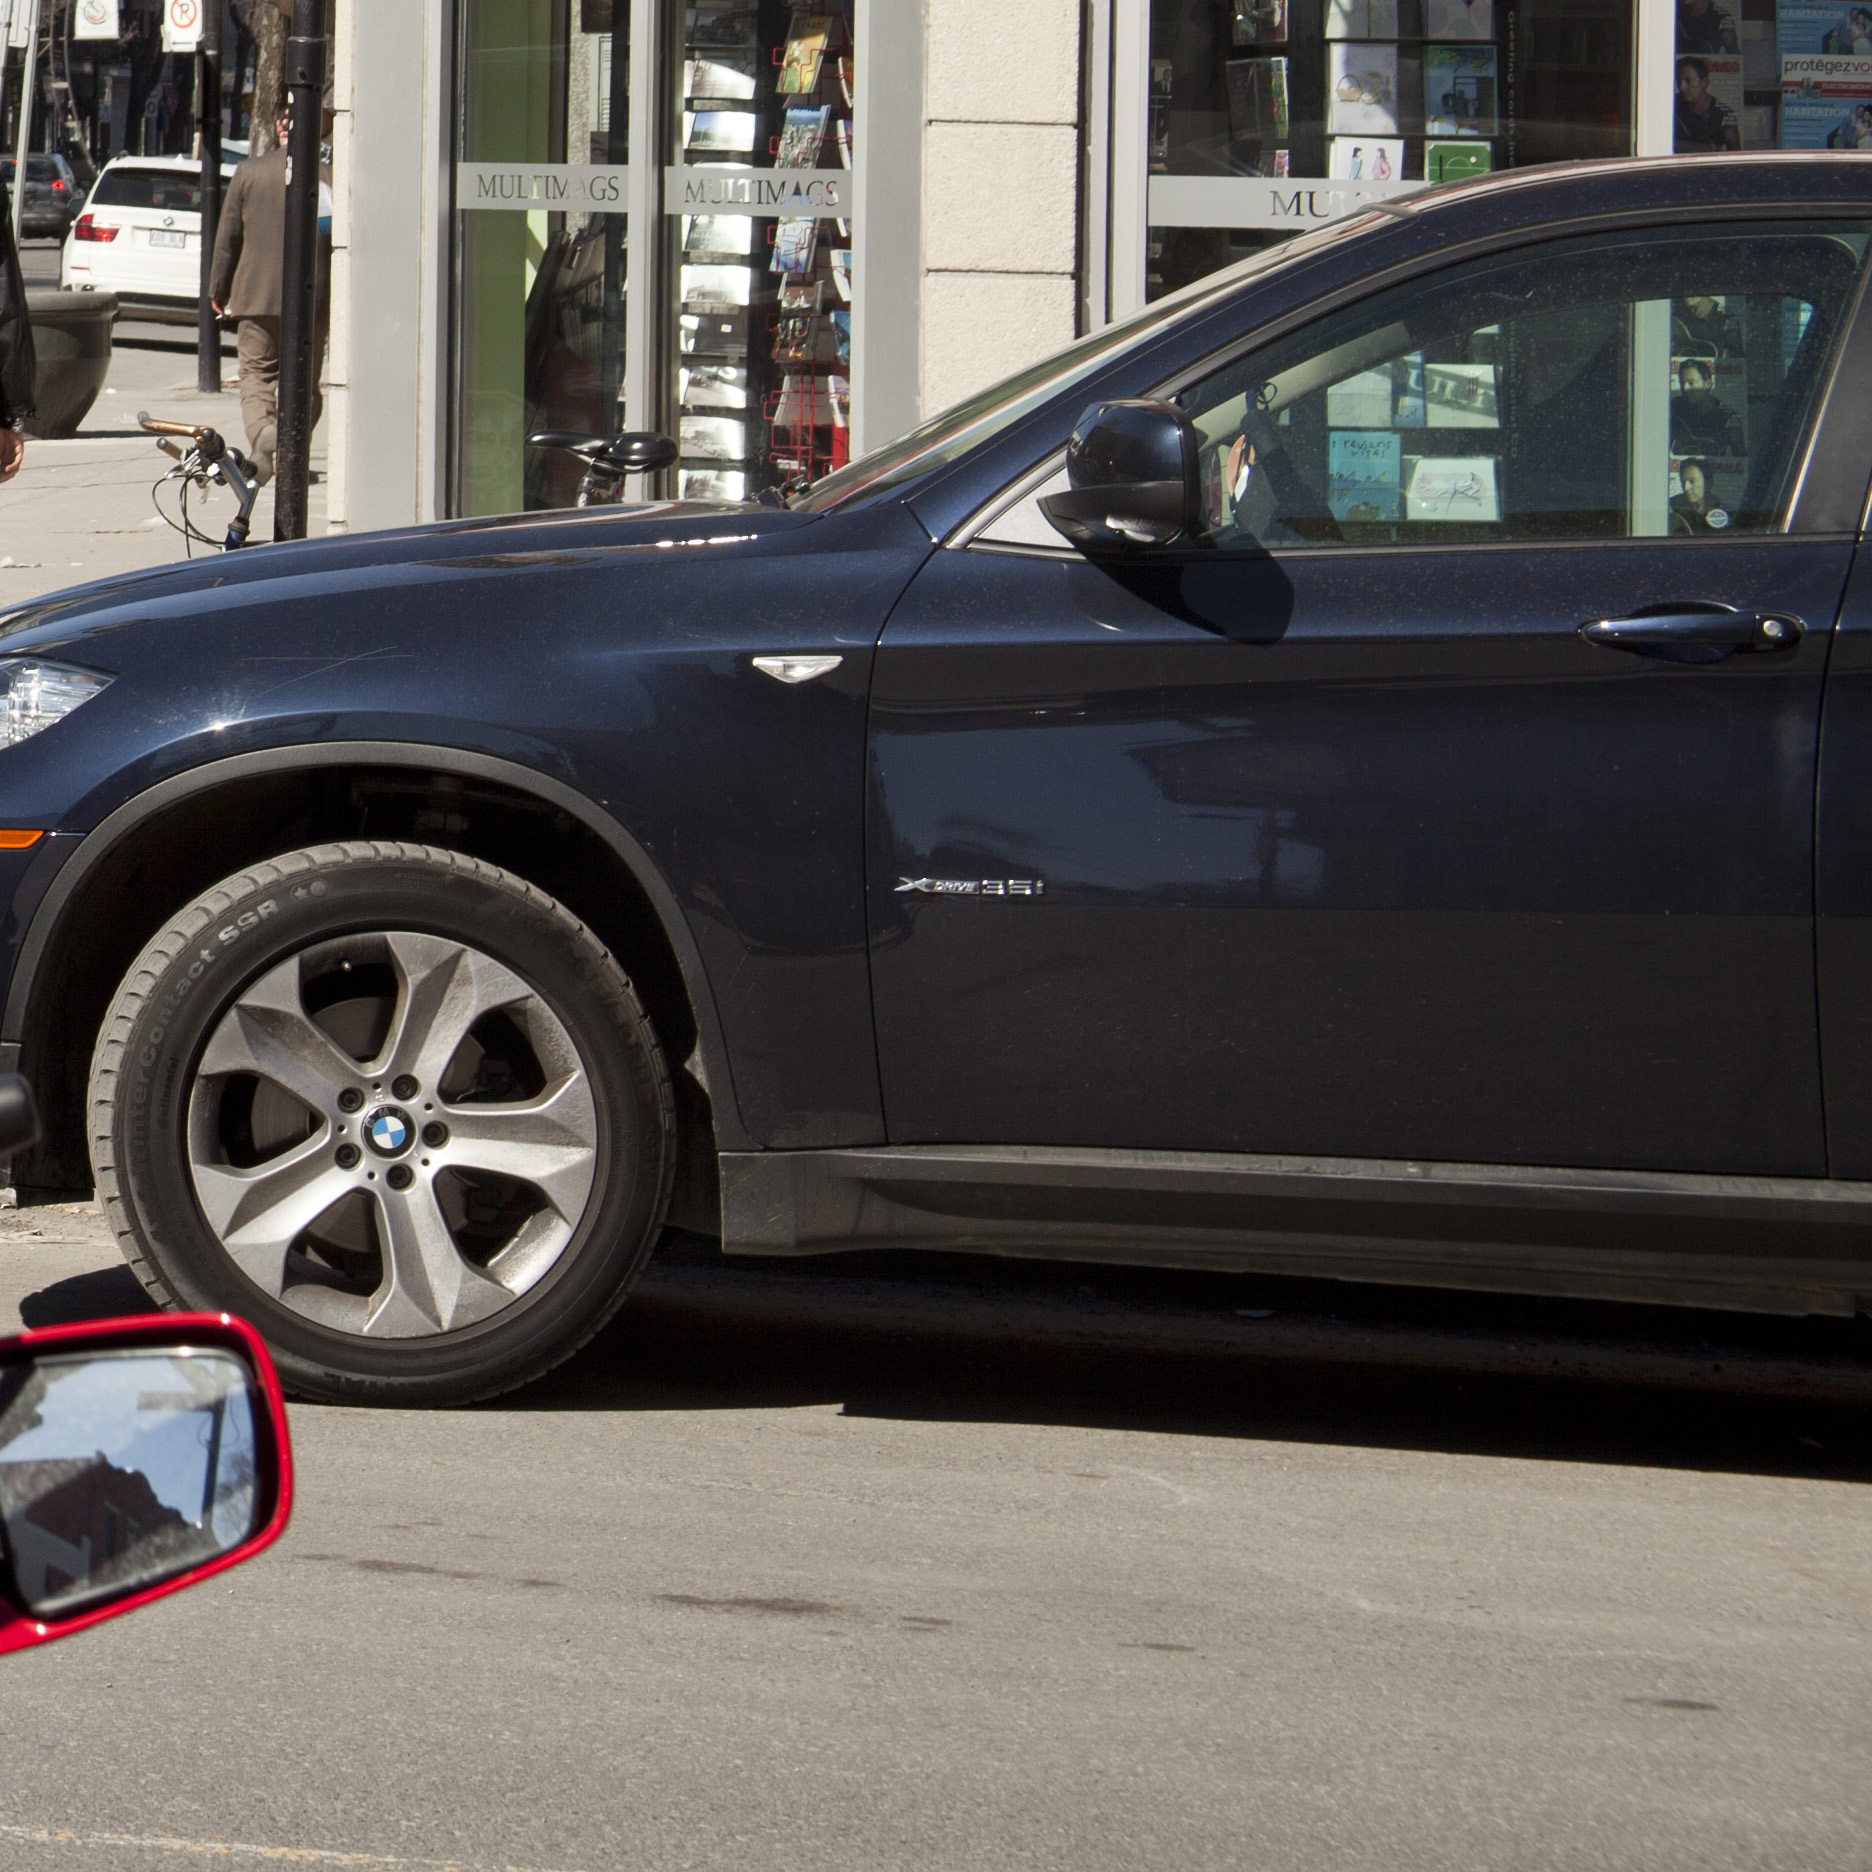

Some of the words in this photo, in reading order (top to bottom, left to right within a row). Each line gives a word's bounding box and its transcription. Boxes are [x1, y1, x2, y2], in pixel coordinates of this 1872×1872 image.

[1784, 59, 1872, 76] protégezvo
[1785, 106, 1850, 117] HABITATION
[476, 173, 620, 202] MULTIMAGS
[685, 178, 838, 207] MULTIMAGS
[217, 896, 280, 947] SSR
